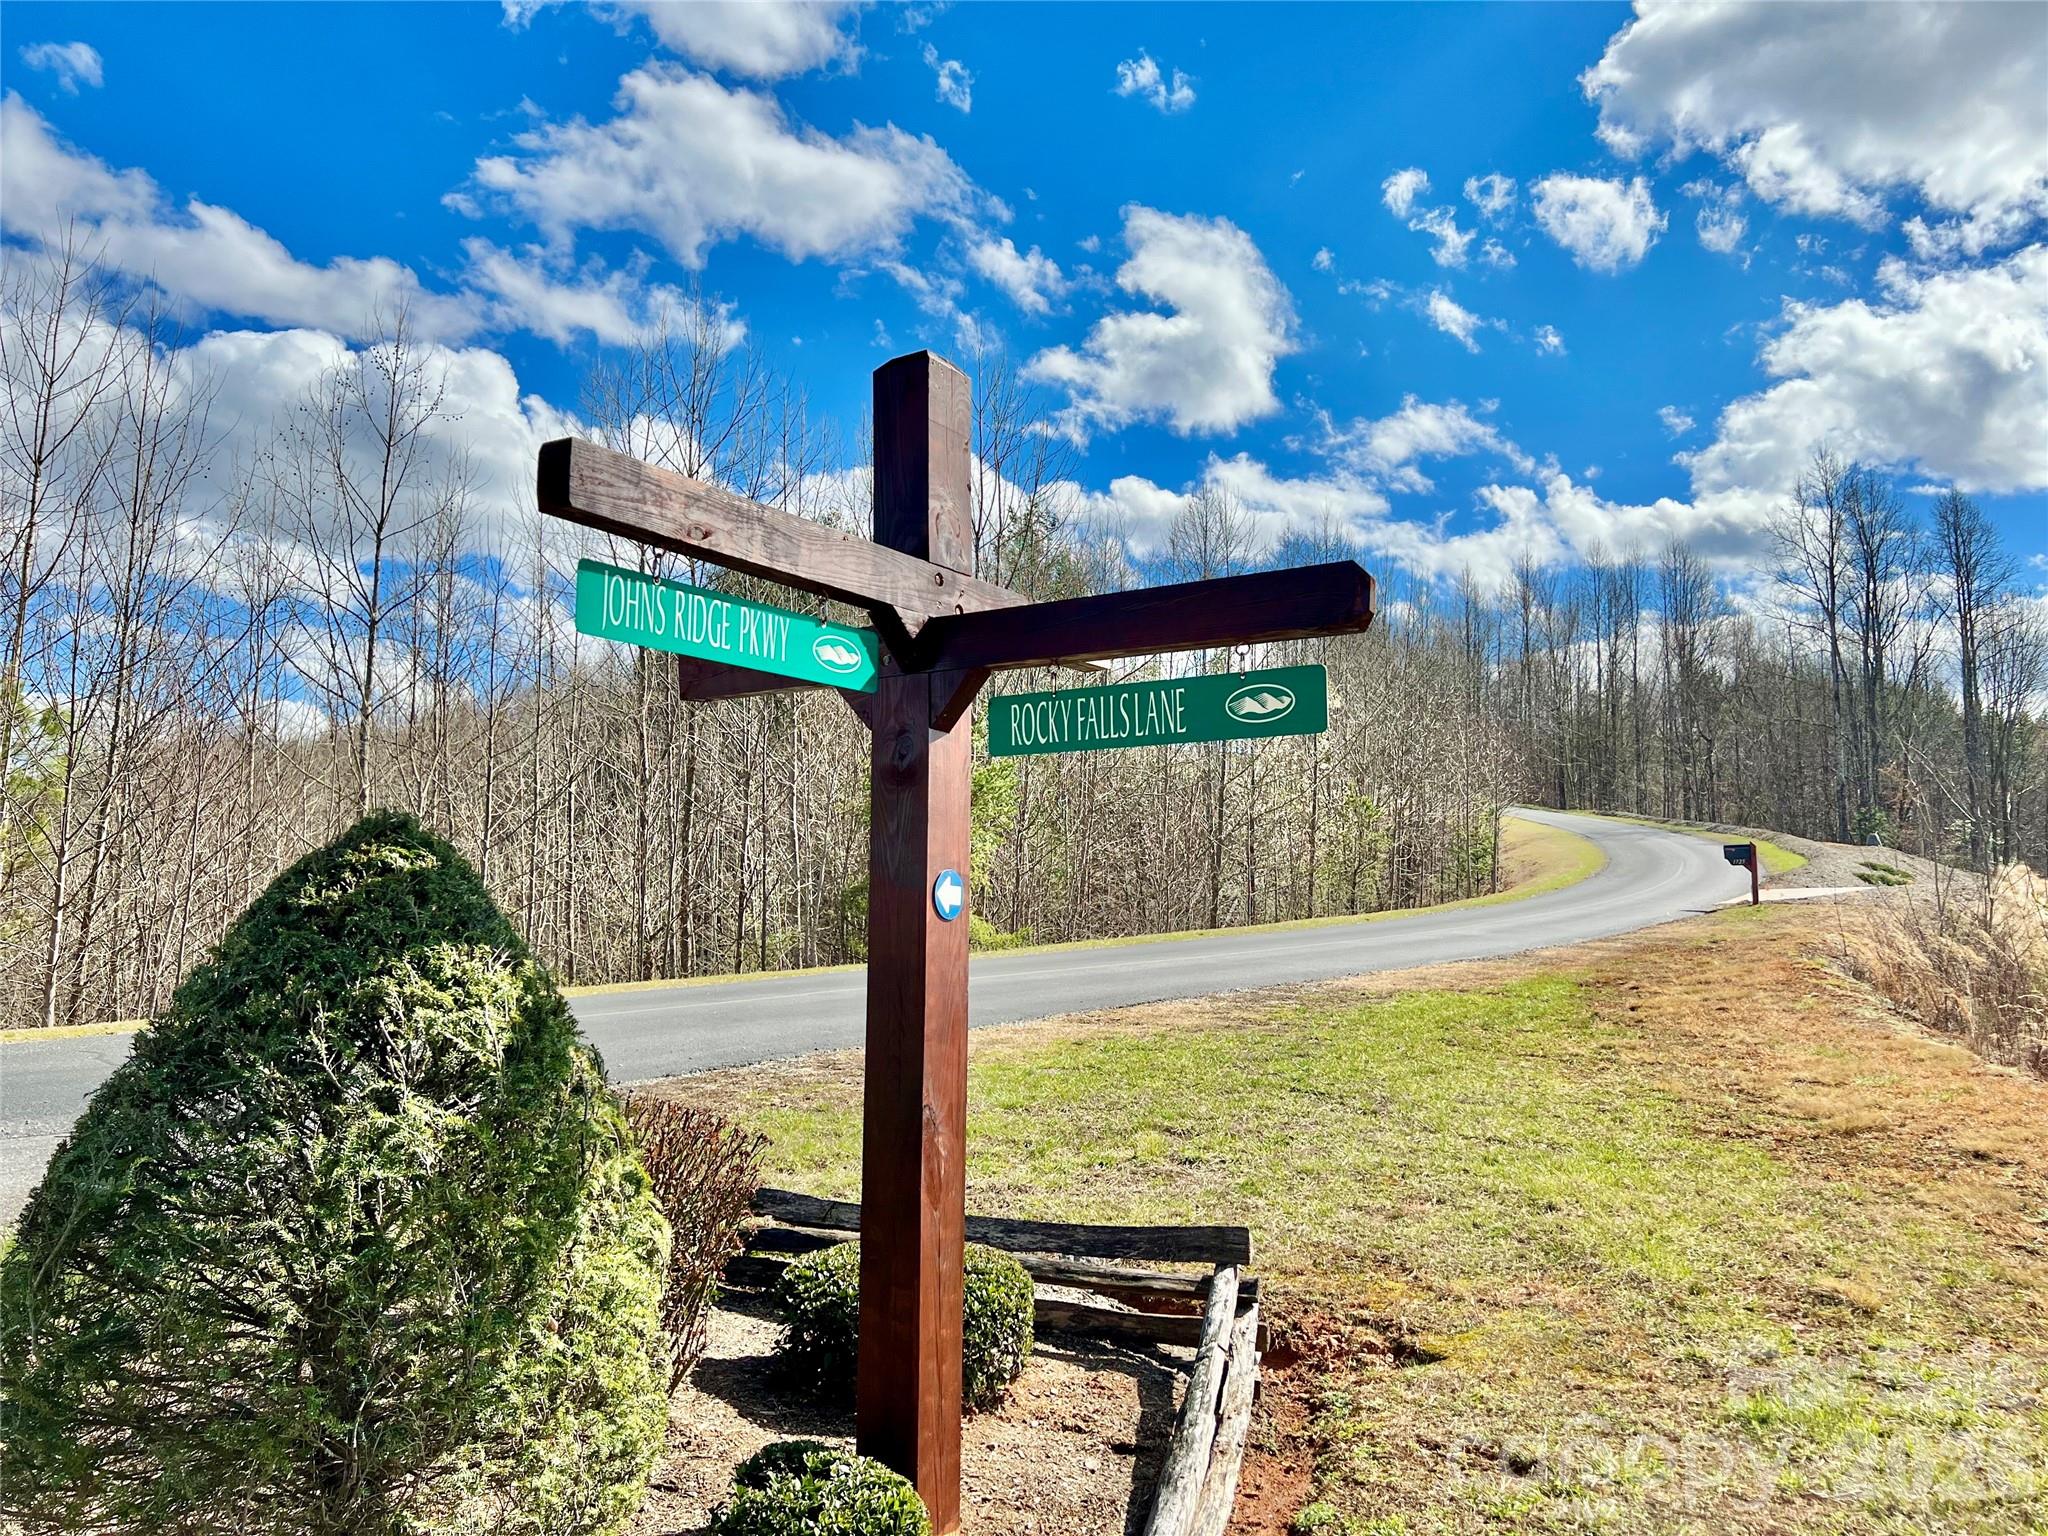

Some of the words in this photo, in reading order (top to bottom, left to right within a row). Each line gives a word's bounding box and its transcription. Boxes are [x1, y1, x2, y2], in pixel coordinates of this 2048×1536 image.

[601, 570, 667, 635] JOHNS
[674, 590, 731, 650] RIDGE
[739, 606, 790, 662] PKWY
[1011, 698, 1072, 746] ROCKY
[1077, 692, 1130, 740] FALLS
[1135, 687, 1187, 737] LANE
